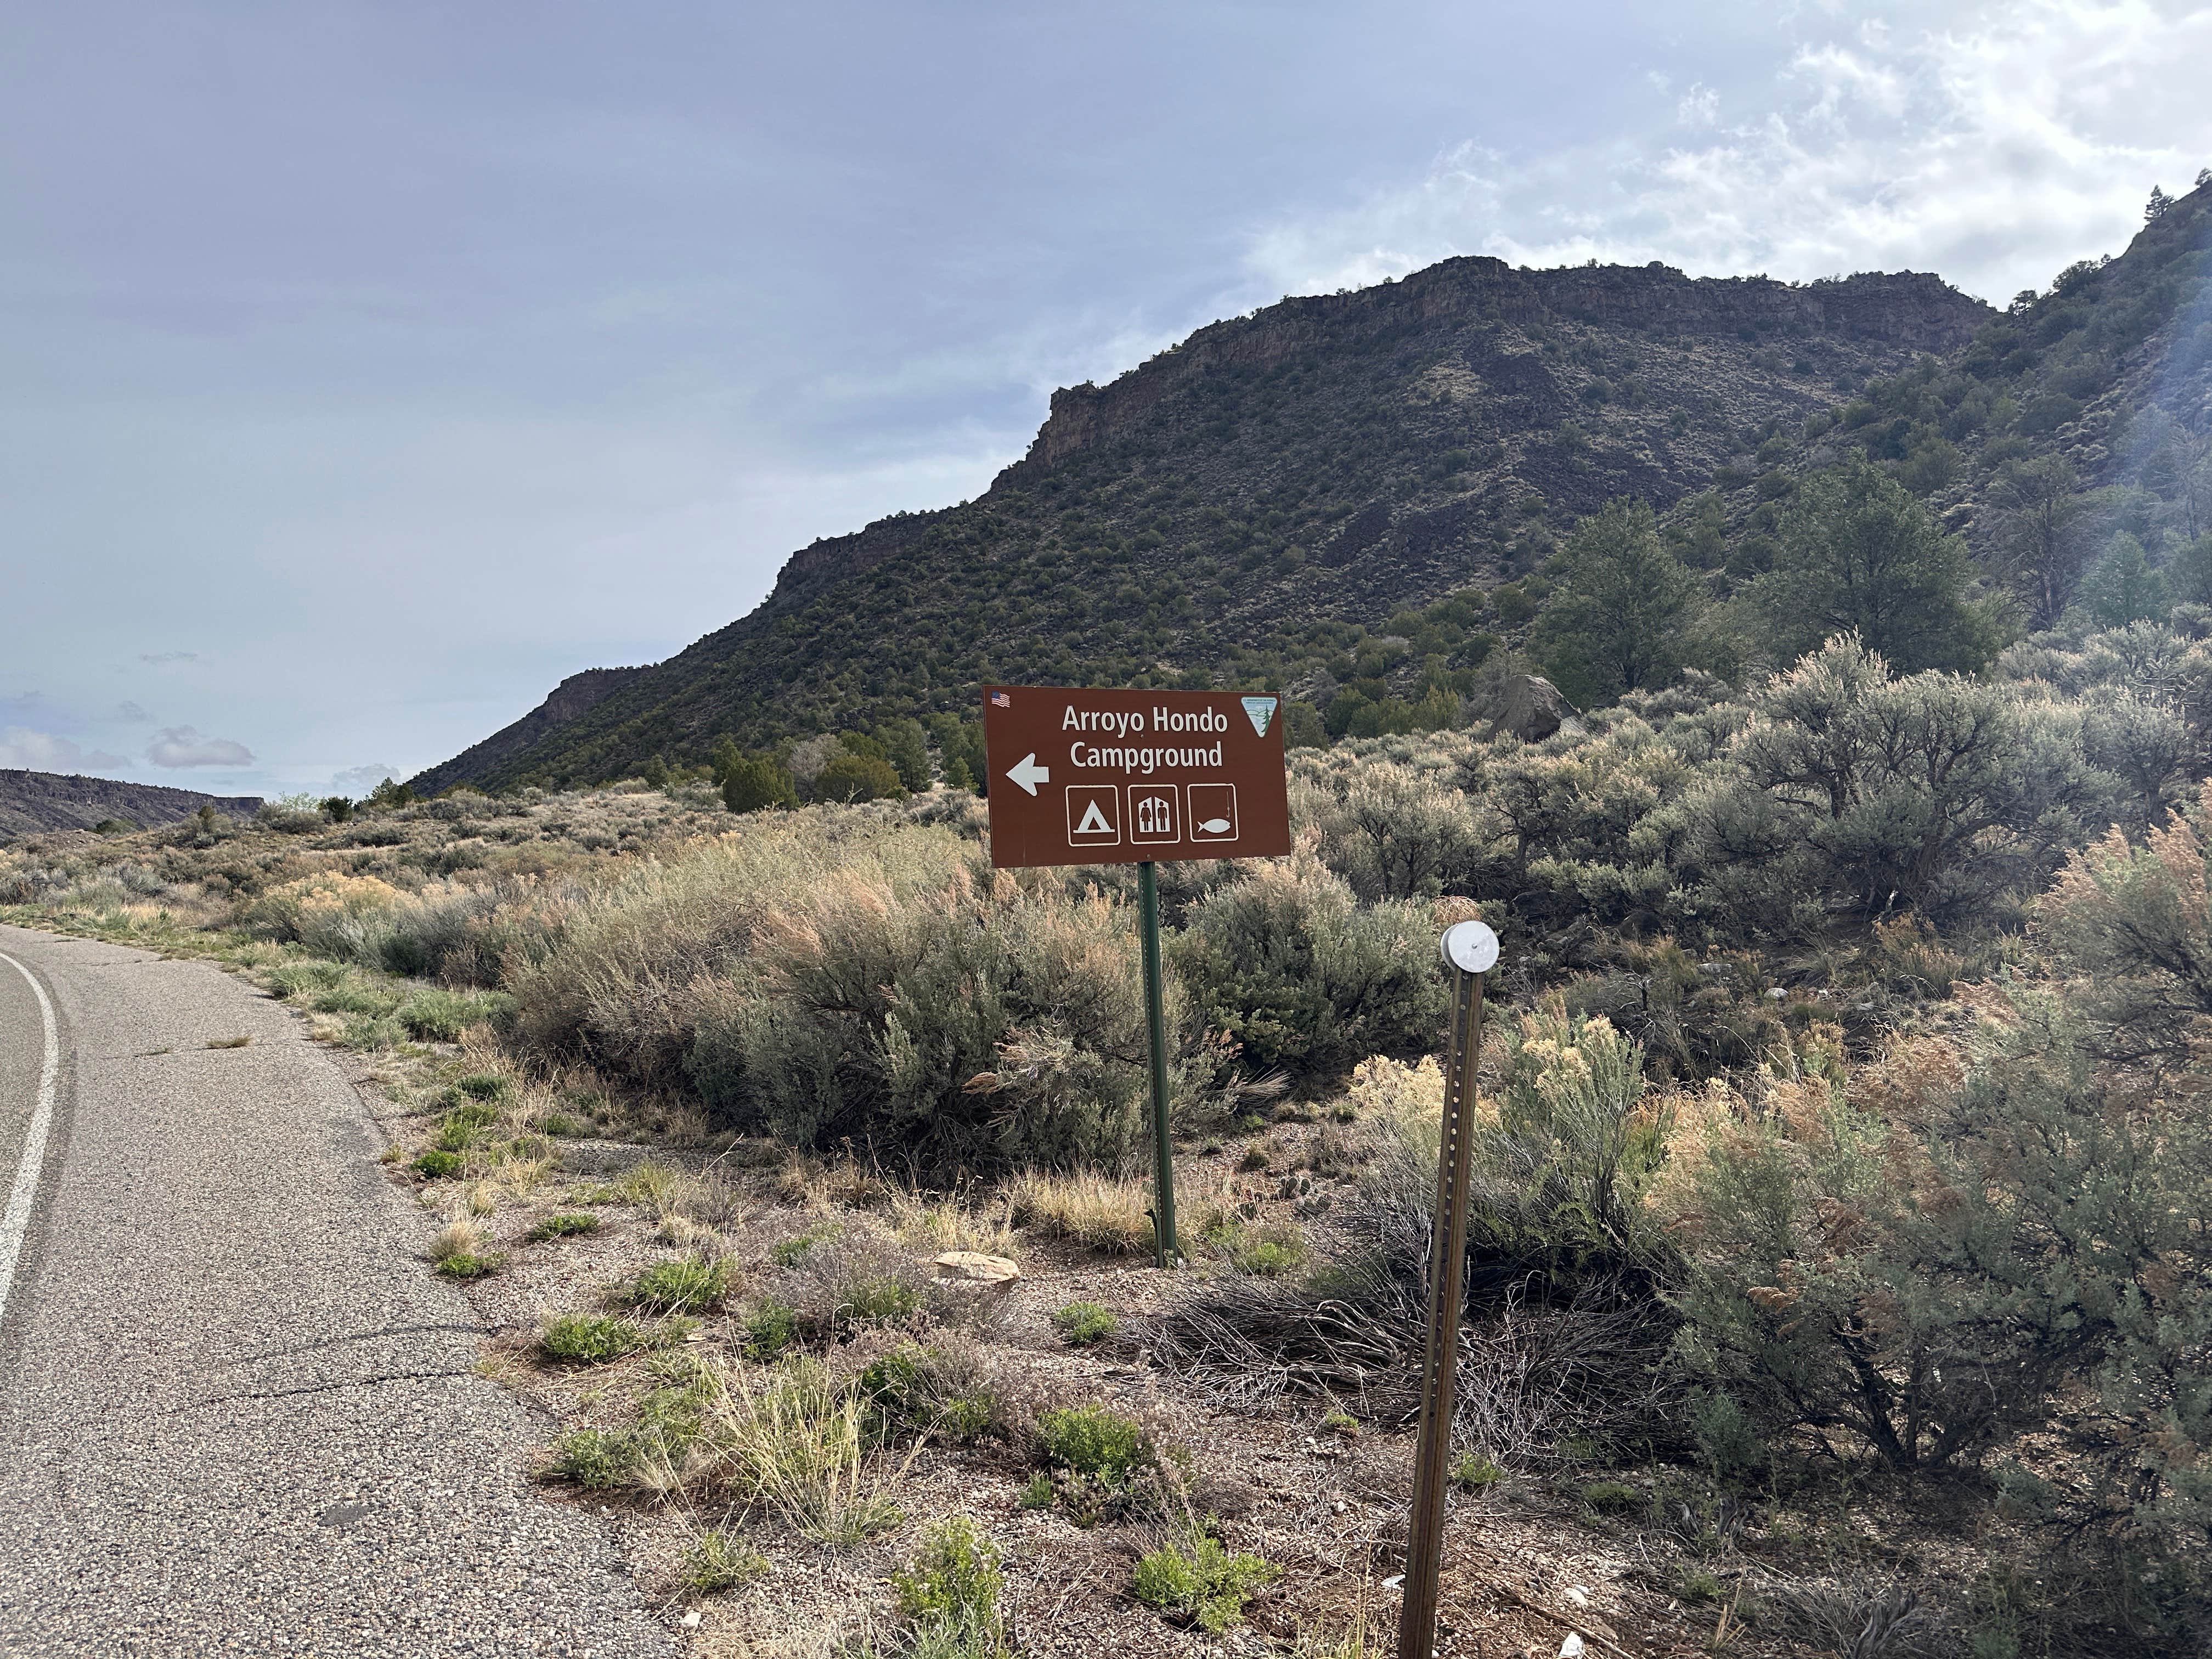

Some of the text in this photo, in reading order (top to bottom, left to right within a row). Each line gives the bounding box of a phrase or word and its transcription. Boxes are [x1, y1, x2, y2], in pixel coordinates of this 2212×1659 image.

[1062, 705, 1228, 738] Arroyo Hondo
[1070, 741, 1222, 774] Campground
